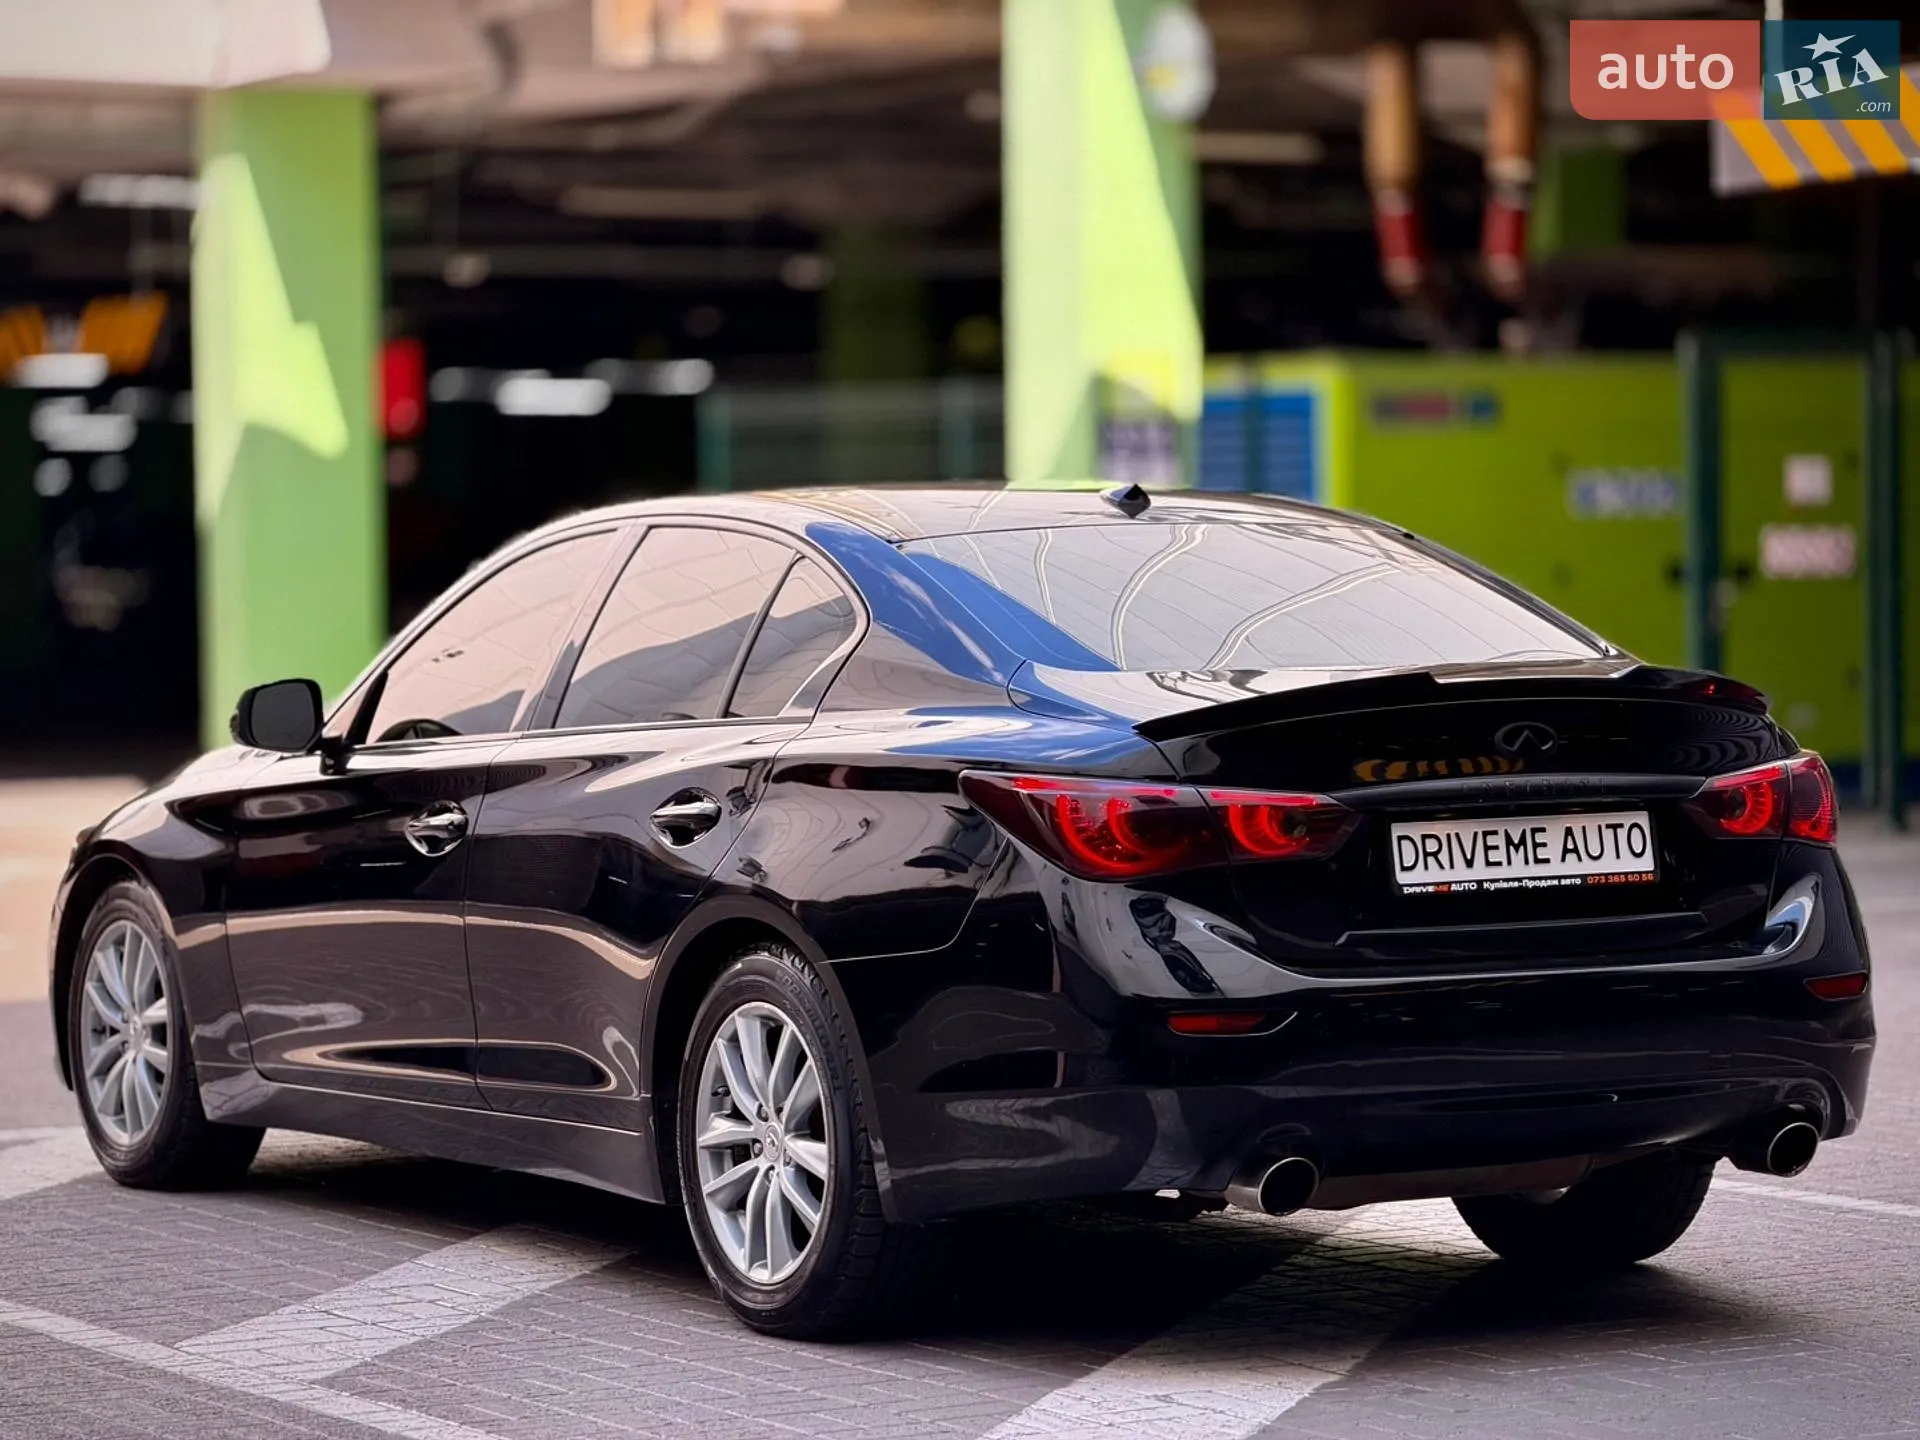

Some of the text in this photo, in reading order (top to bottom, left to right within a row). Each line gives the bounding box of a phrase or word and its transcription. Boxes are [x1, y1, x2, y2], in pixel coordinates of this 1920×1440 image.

[1396, 822, 1648, 872] DRIVEME AUTO
[1450, 881, 1478, 892] AUTO
